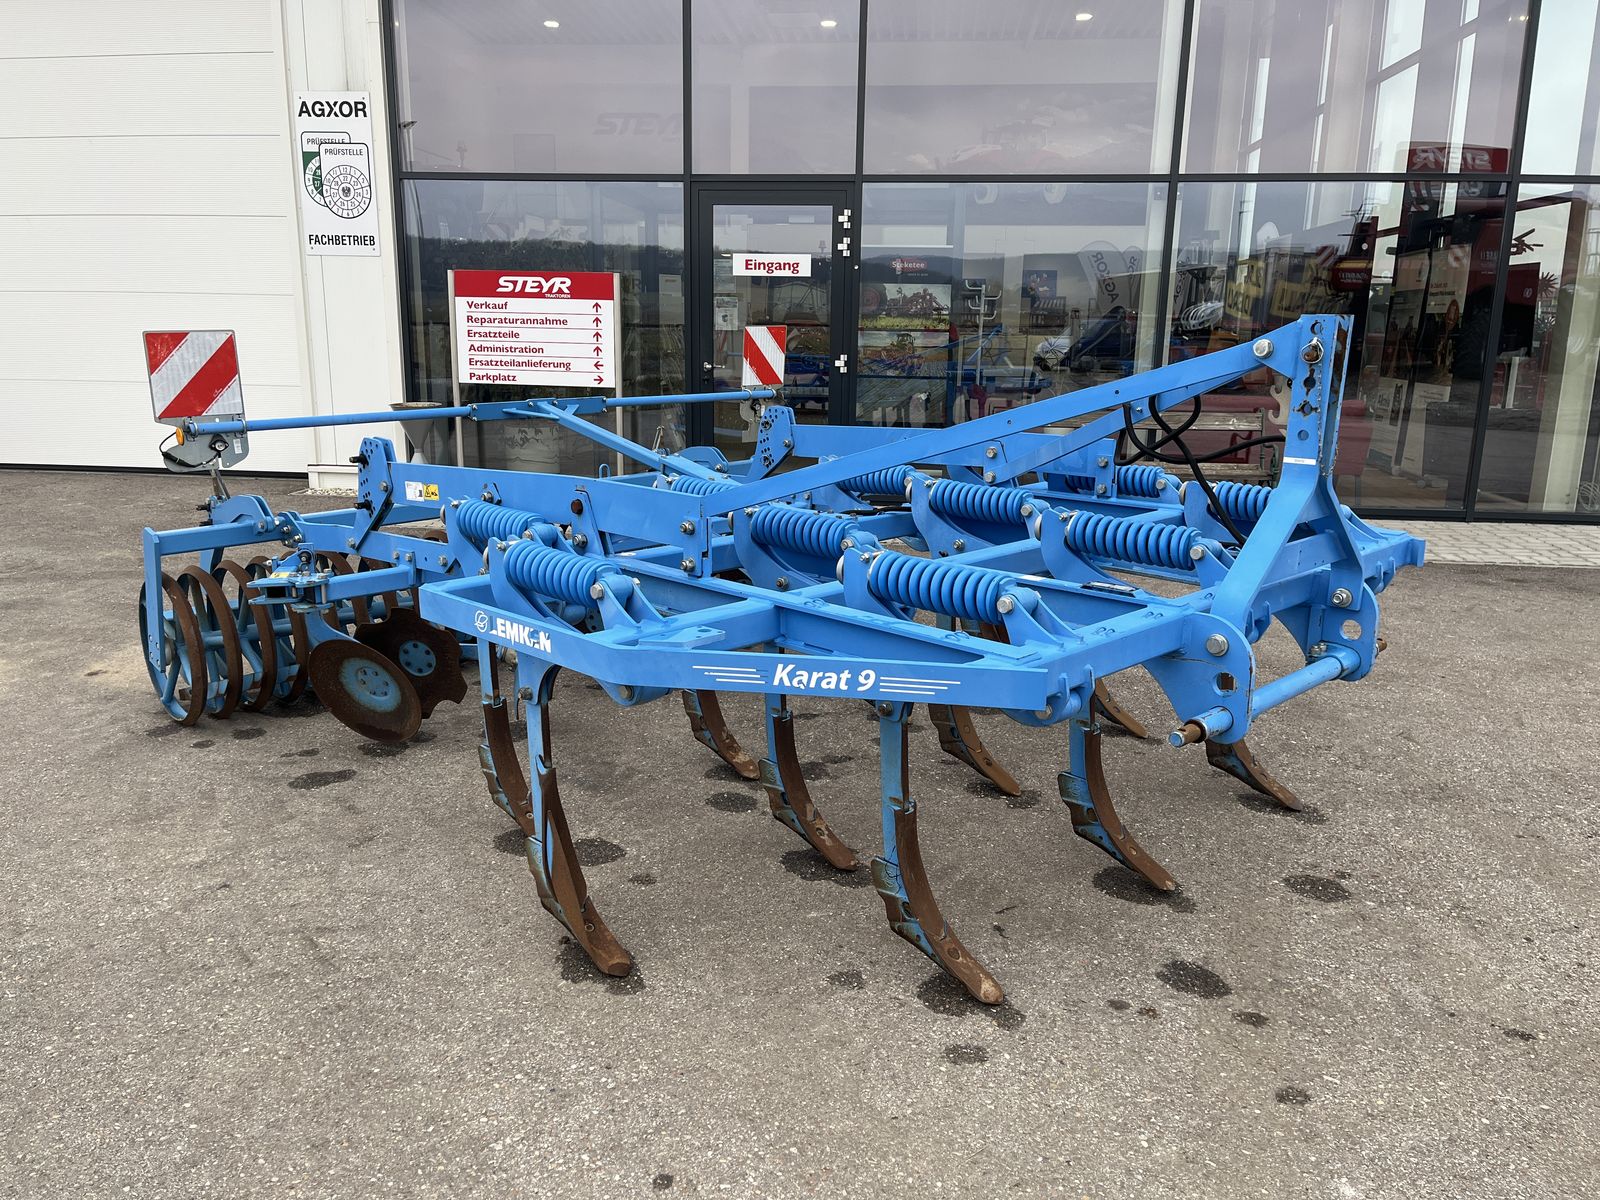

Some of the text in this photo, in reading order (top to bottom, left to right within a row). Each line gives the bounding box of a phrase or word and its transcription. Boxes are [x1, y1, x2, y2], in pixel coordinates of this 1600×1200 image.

[298, 101, 367, 117] AGXOR
[324, 148, 364, 156] PRÜFSTELLE
[308, 234, 376, 247] FACHBETRIEB
[745, 259, 800, 274] Eingang
[495, 276, 572, 293] STEYR
[466, 301, 508, 310] Verkauf
[466, 315, 568, 326] Reparaturannahme
[467, 330, 520, 339] Ersatzteile
[468, 344, 544, 354] Administration
[468, 358, 571, 371] Ersatzteilanlieferung
[469, 372, 517, 384] Parkplatz
[773, 663, 876, 691] Karat 9
